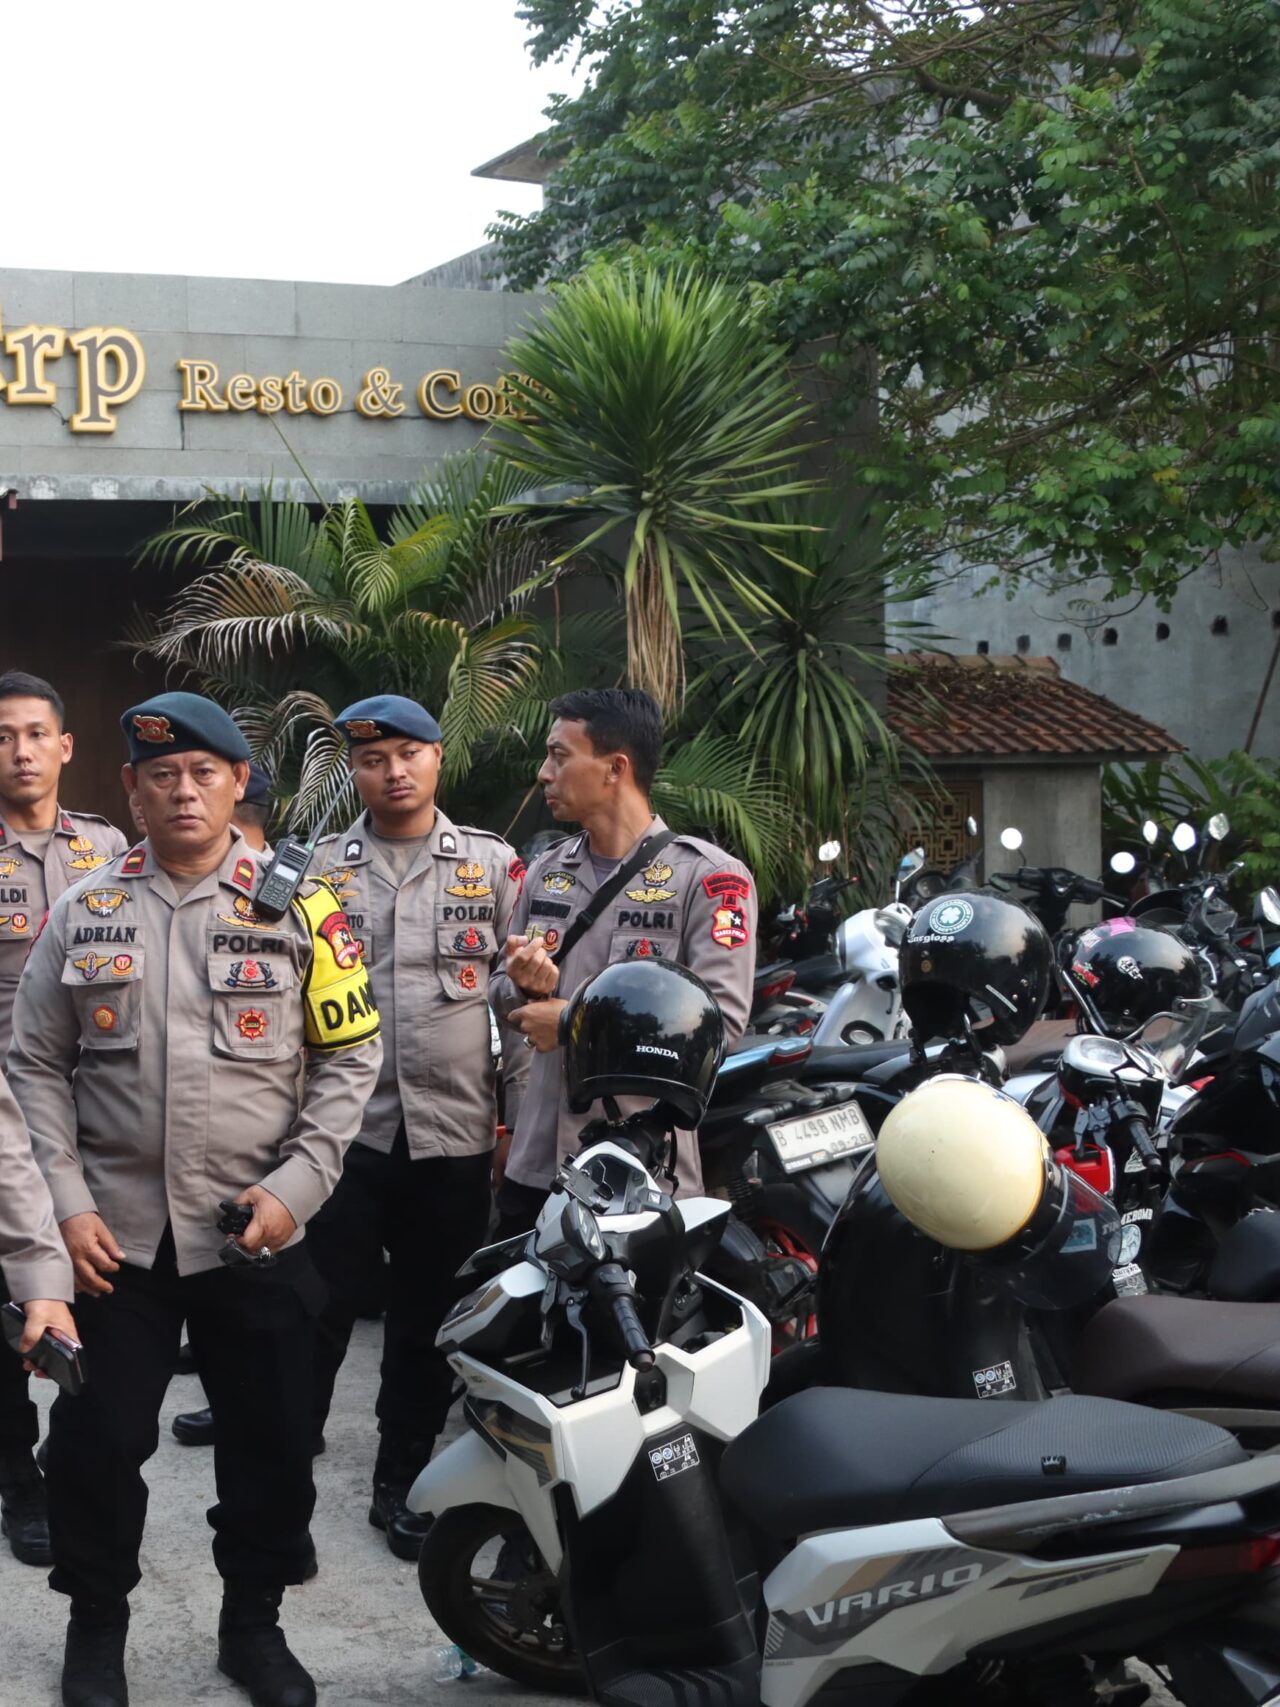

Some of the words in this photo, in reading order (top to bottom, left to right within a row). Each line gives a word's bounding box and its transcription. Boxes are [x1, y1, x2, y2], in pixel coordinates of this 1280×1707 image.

[178, 358, 342, 416] Resto
[355, 366, 407, 419] &
[443, 905, 494, 921] POLRI
[619, 911, 675, 929] POLRI
[73, 926, 137, 945] ADRIAN
[213, 933, 288, 953] POLRI
[635, 1044, 680, 1061] HONDA
[775, 1130, 787, 1147] B
[829, 1108, 860, 1131] NMB
[804, 1562, 984, 1628] VARIO
